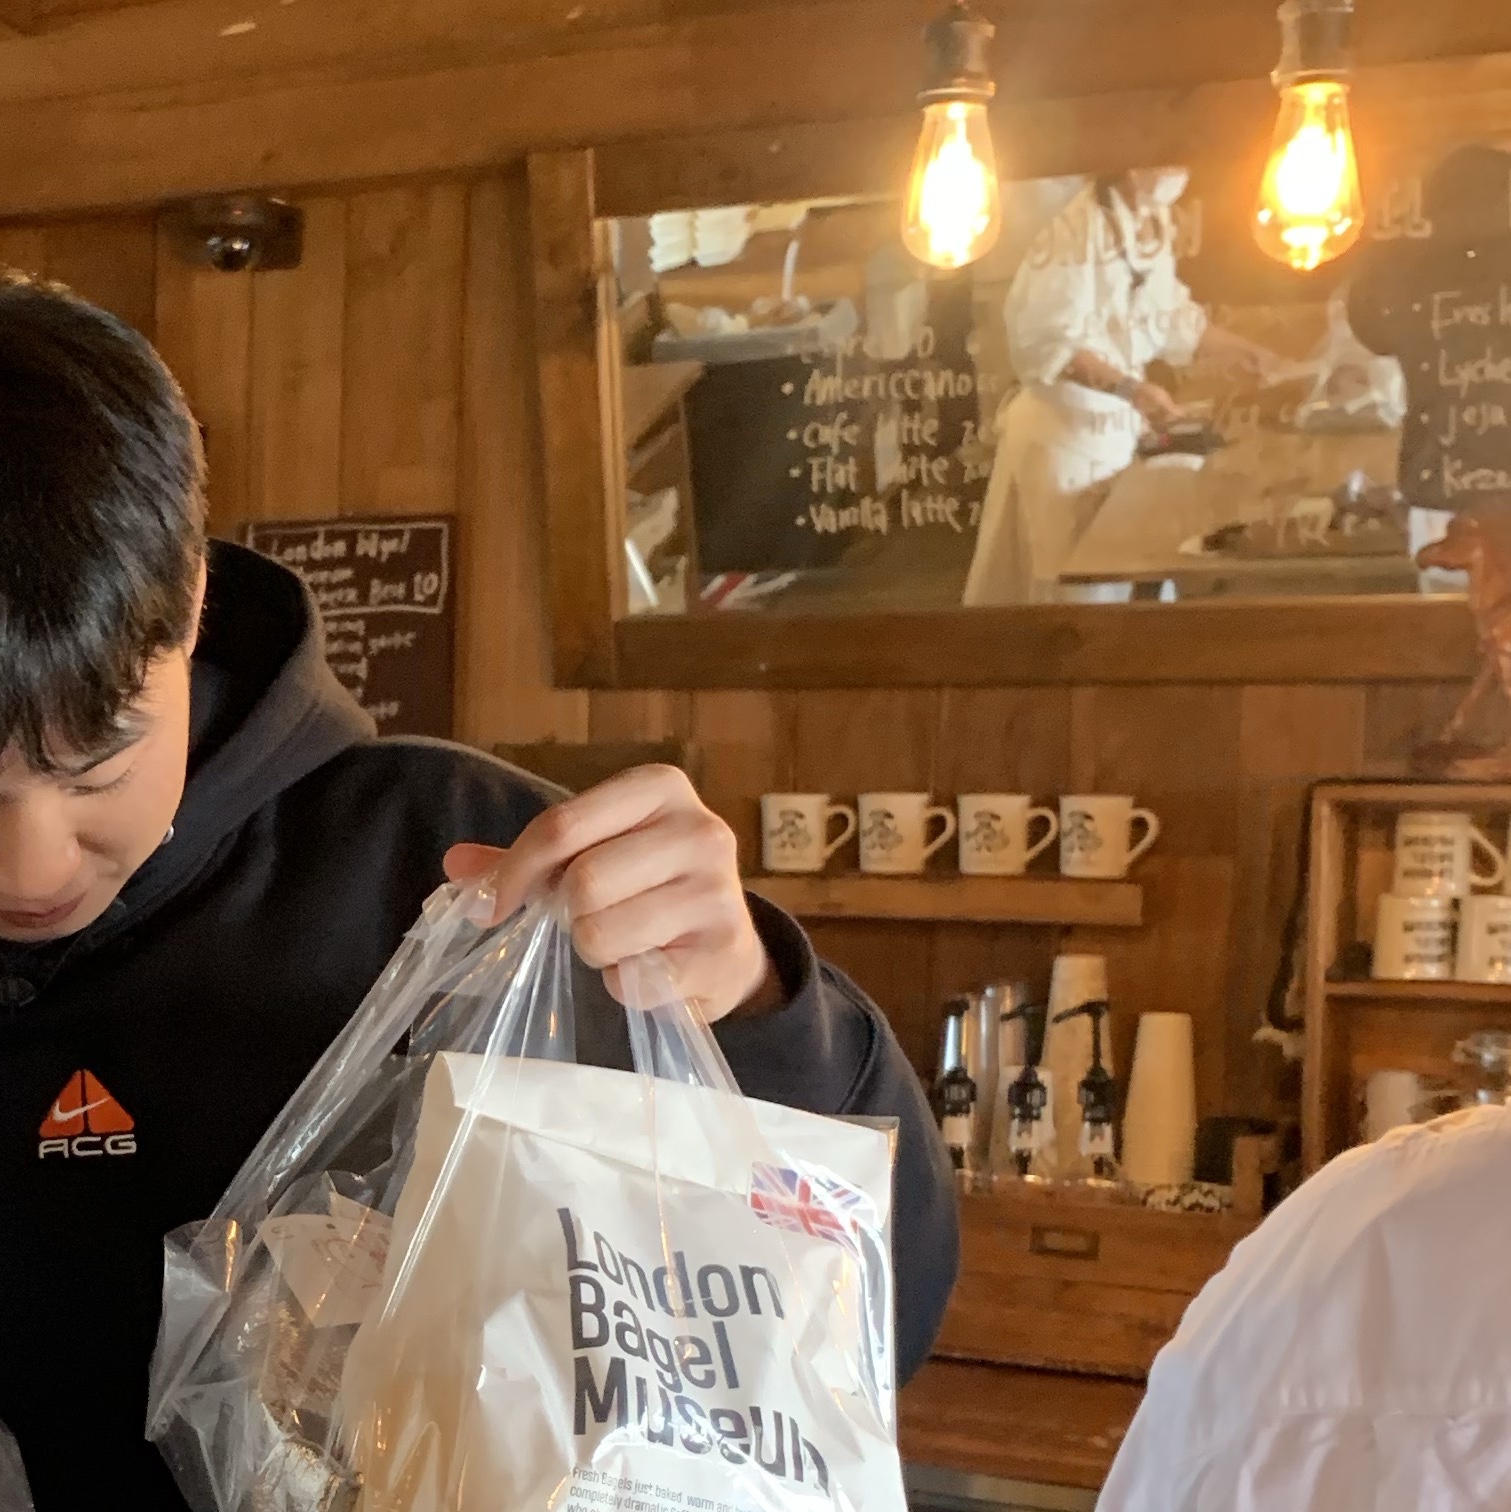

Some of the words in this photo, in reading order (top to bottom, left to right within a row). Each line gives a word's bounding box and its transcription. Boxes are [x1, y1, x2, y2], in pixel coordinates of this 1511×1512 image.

[38, 1133, 137, 1160] ACG
[556, 1207, 785, 1320] London
[568, 1275, 739, 1394] Bagel
[570, 1484, 622, 1510] completely
